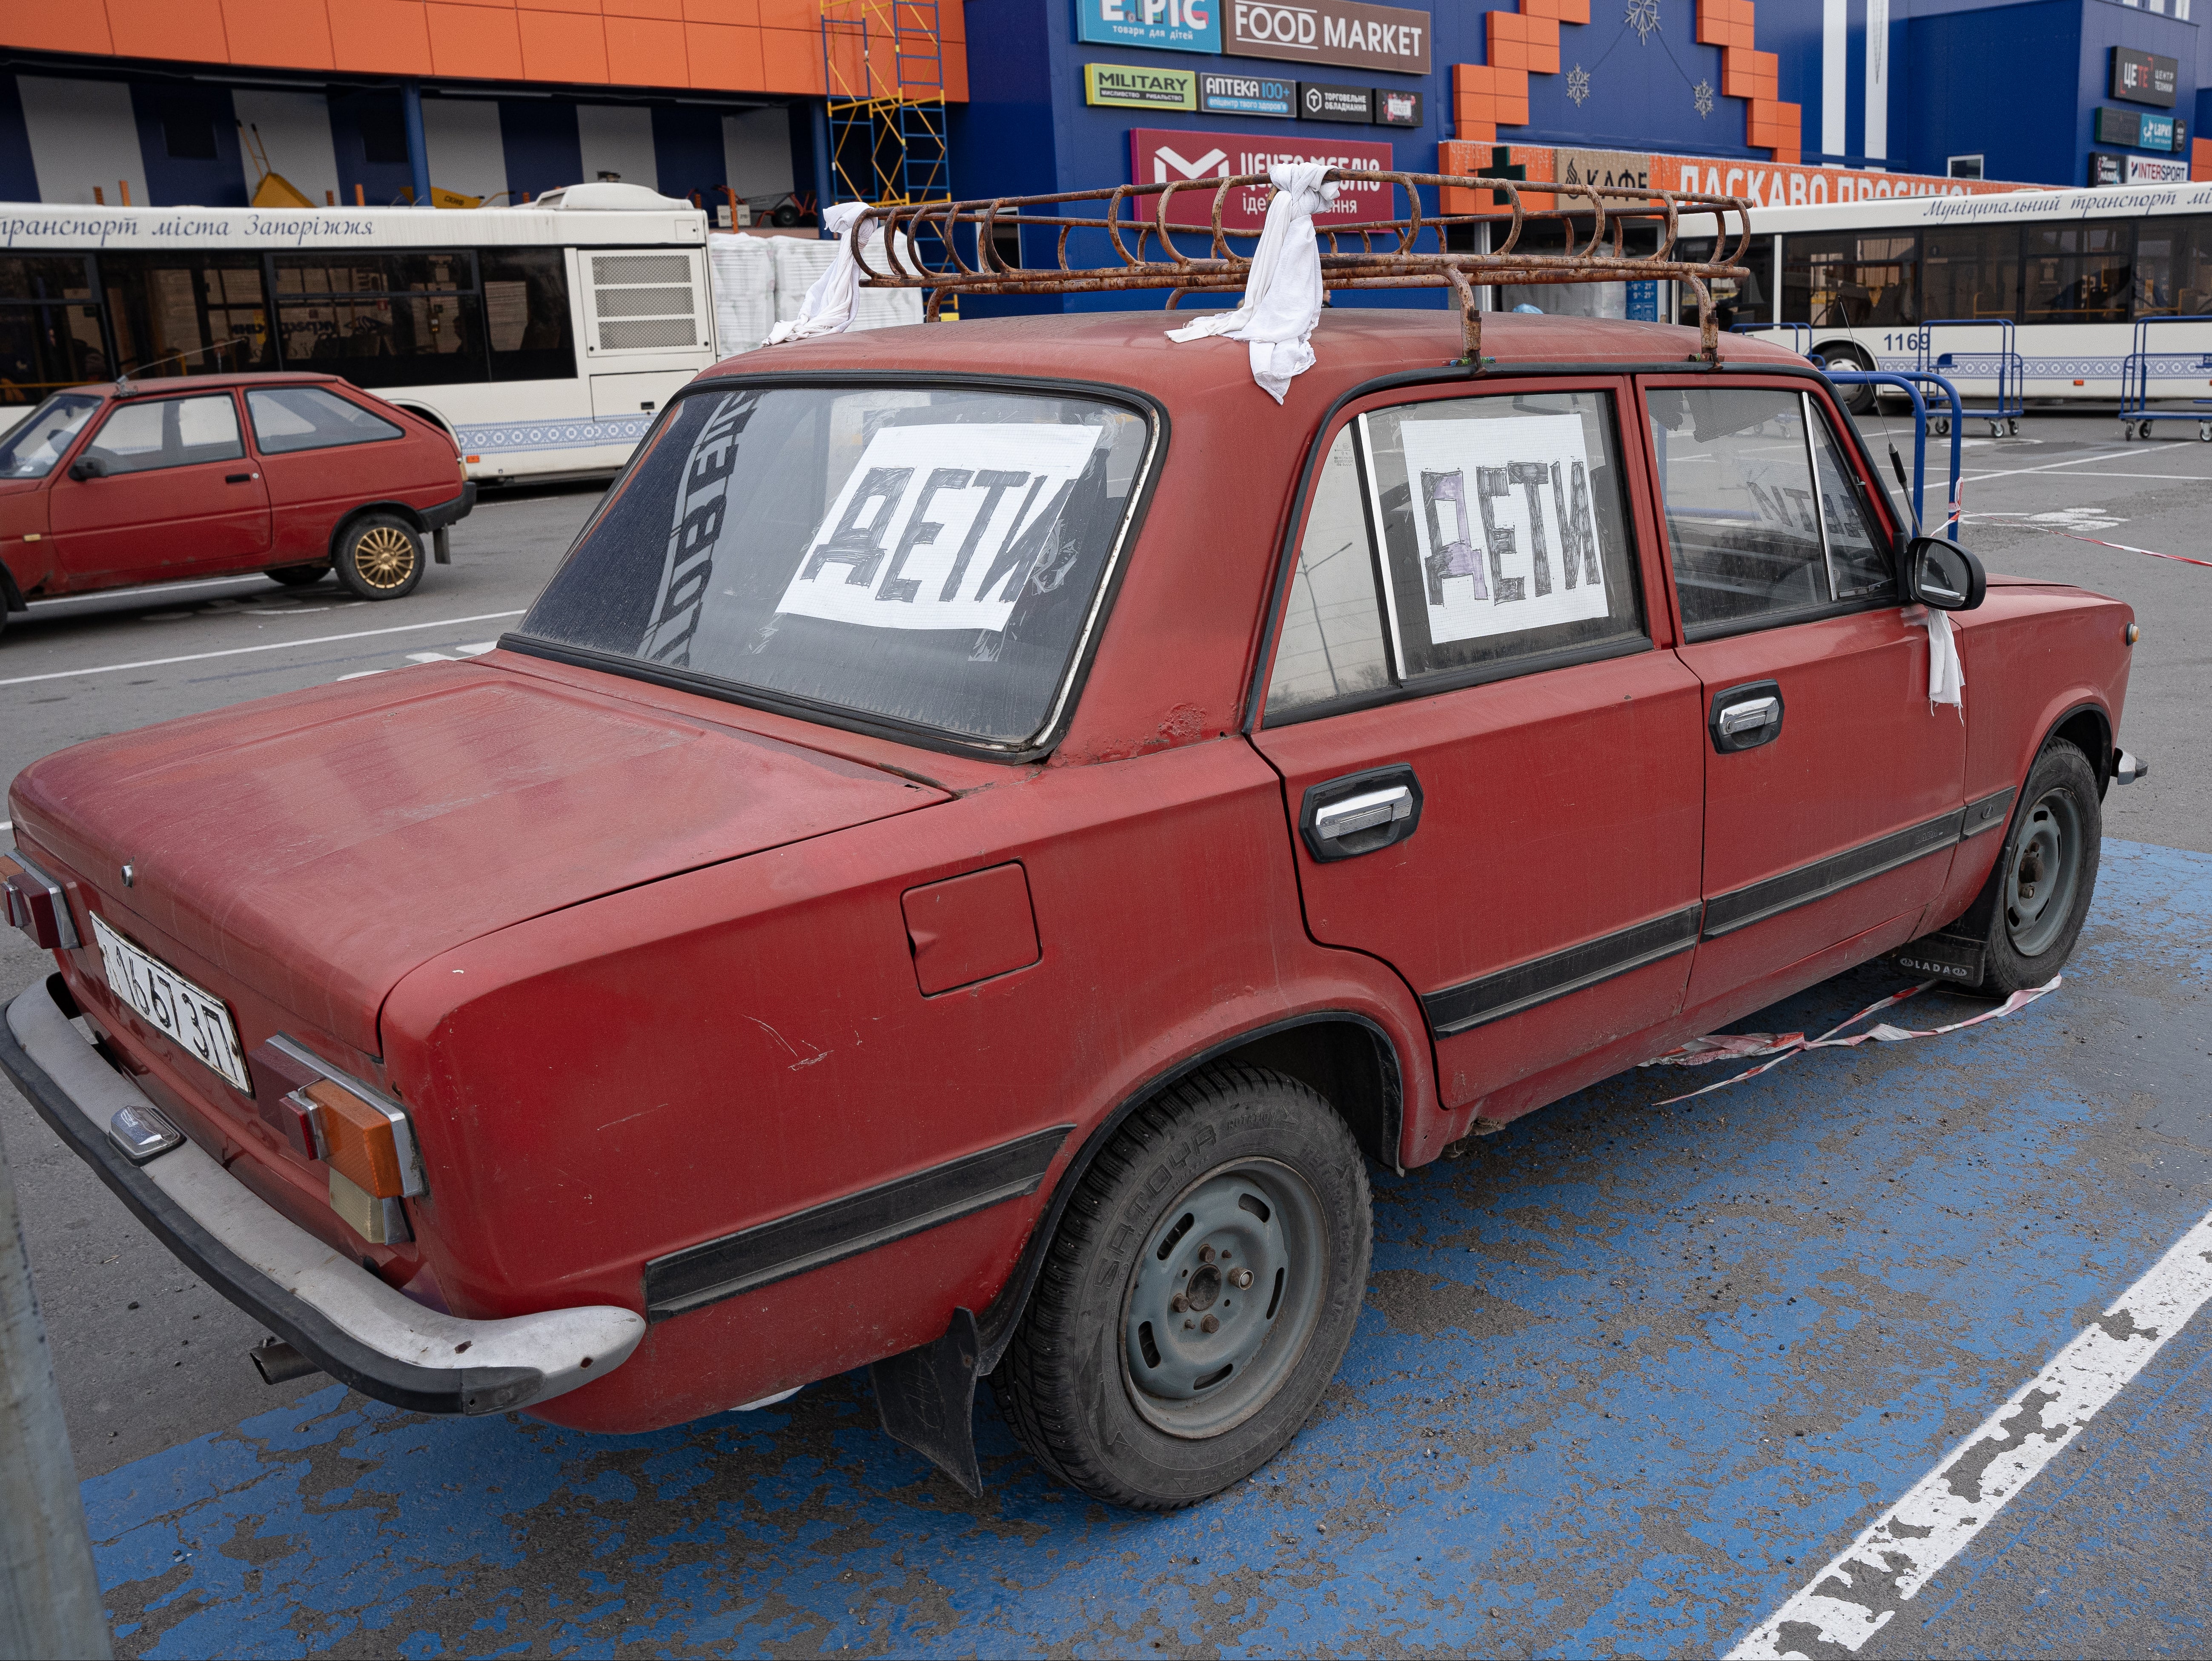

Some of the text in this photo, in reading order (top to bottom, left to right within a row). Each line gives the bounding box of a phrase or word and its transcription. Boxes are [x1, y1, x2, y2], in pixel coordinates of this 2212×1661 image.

[1113, 25, 1193, 40] товари для дітей
[1235, 4, 1422, 57] FOOD MARKET
[1098, 72, 1188, 91] MILITARY
[2123, 62, 2149, 88] ЦЕТЕ
[1101, 89, 1183, 101] МИСЛИВСТВО РИБАЛЬСТВО
[1206, 77, 1259, 97] АПТЕКА
[1324, 92, 1367, 103] ТОРГОВЕЛЬНЕ
[1324, 101, 1367, 112] ОБЛАДНАННЯ
[1240, 152, 1381, 192] ЦЕН БЛІВ
[2138, 163, 2185, 181] INTERSPORT
[1587, 169, 1648, 201] КАФЕ
[1676, 165, 1828, 207] ЛАСКАВО
[1242, 192, 1268, 215] іде
[1923, 195, 2061, 224] Муніципальний
[2071, 190, 2177, 217] транспорт
[151, 216, 232, 235] міста
[244, 214, 375, 245] Запоріжжя
[1884, 333, 1929, 351] 1169
[799, 467, 1079, 603] ДЕТИ
[1420, 461, 1601, 607] ДЕТИ
[1915, 960, 1951, 975] LADA
[1226, 1111, 1277, 1131] ROTATION
[1093, 1123, 1217, 1289] SATOYA
